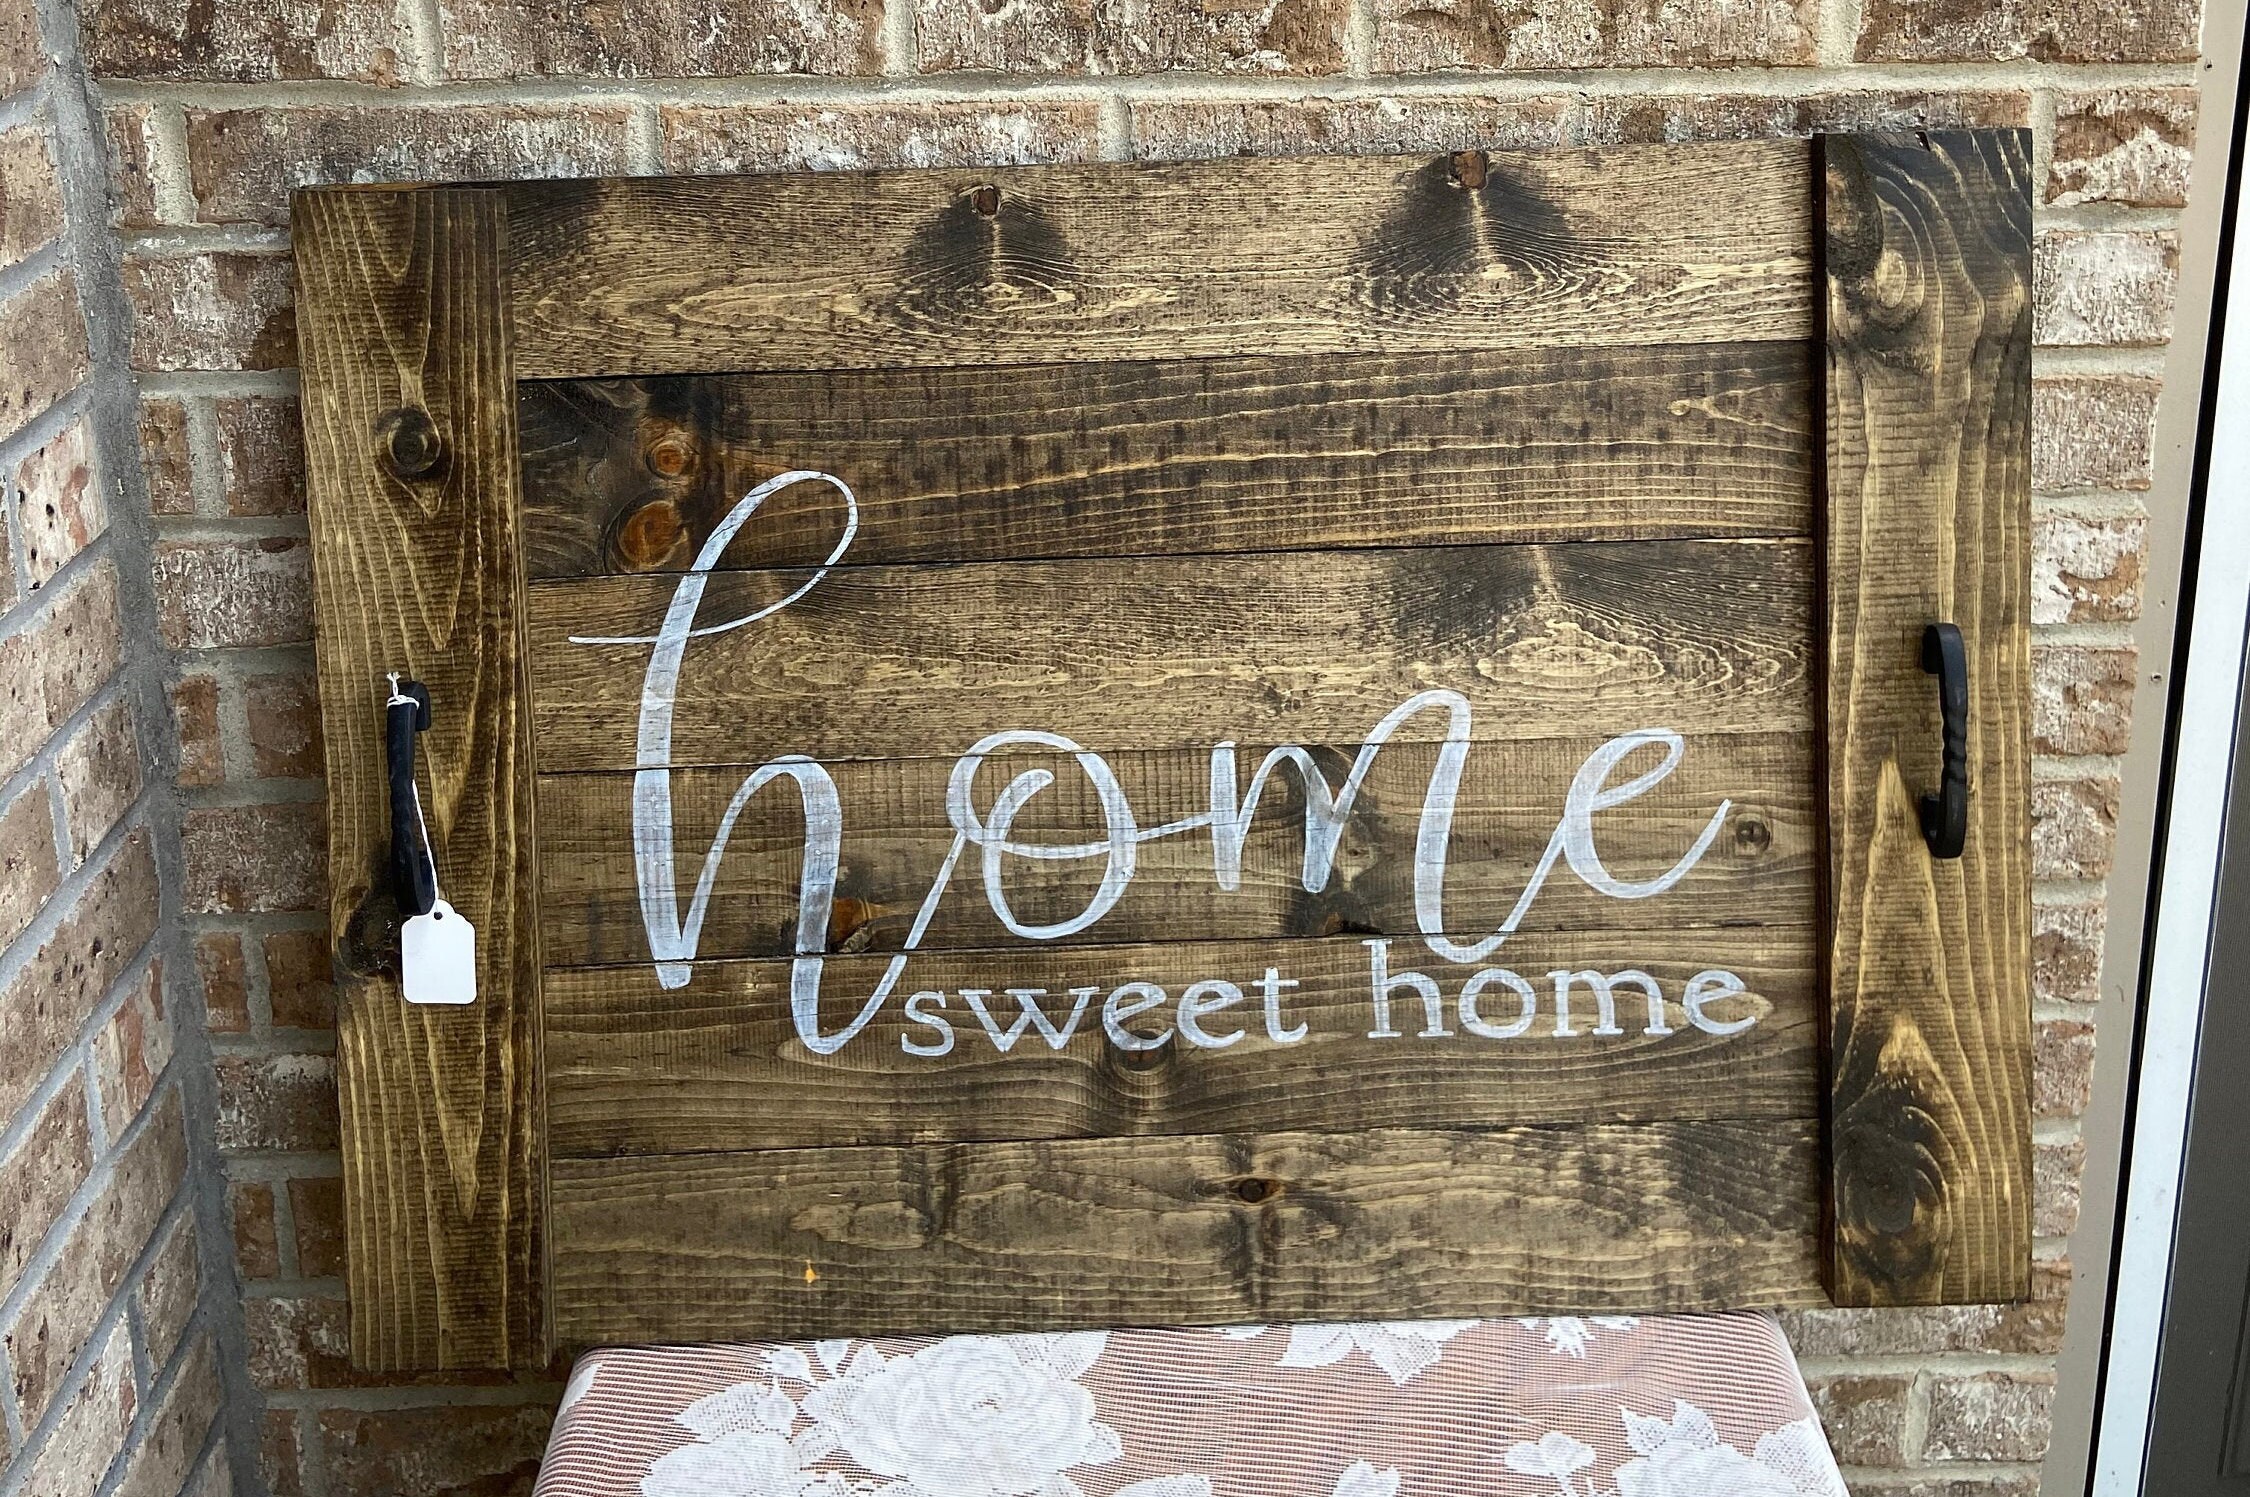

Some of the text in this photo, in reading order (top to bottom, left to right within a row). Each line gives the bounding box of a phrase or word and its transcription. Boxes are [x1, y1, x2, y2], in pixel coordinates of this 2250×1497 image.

[568, 470, 1732, 1054] home
[901, 938, 1757, 1055] sweet home
